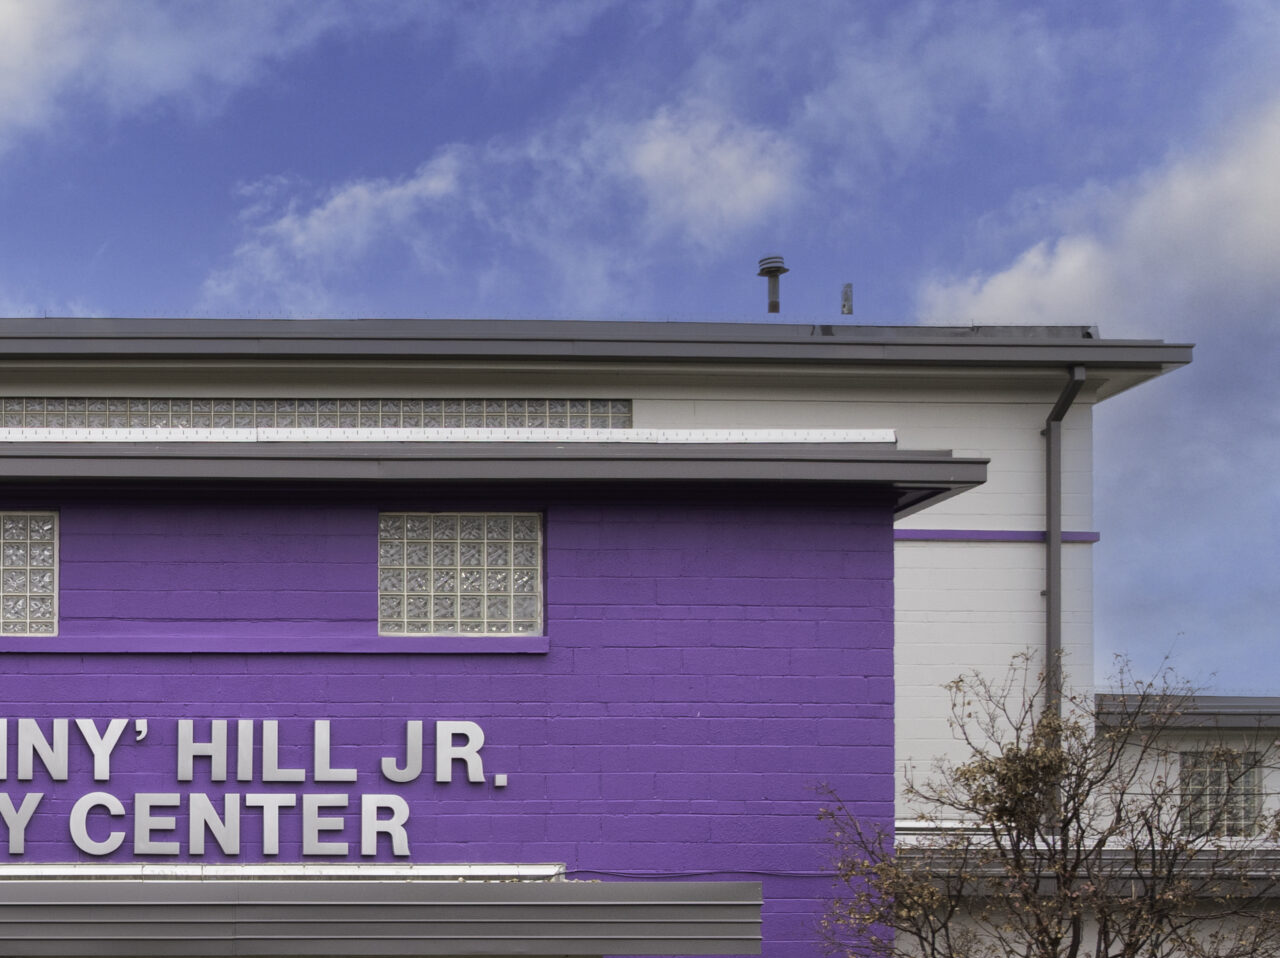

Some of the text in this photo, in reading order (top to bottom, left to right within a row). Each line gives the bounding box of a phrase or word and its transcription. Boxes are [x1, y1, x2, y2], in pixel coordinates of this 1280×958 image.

[177, 719, 357, 782] HILL
[381, 720, 508, 787] JR.
[69, 791, 410, 856] CENTER
